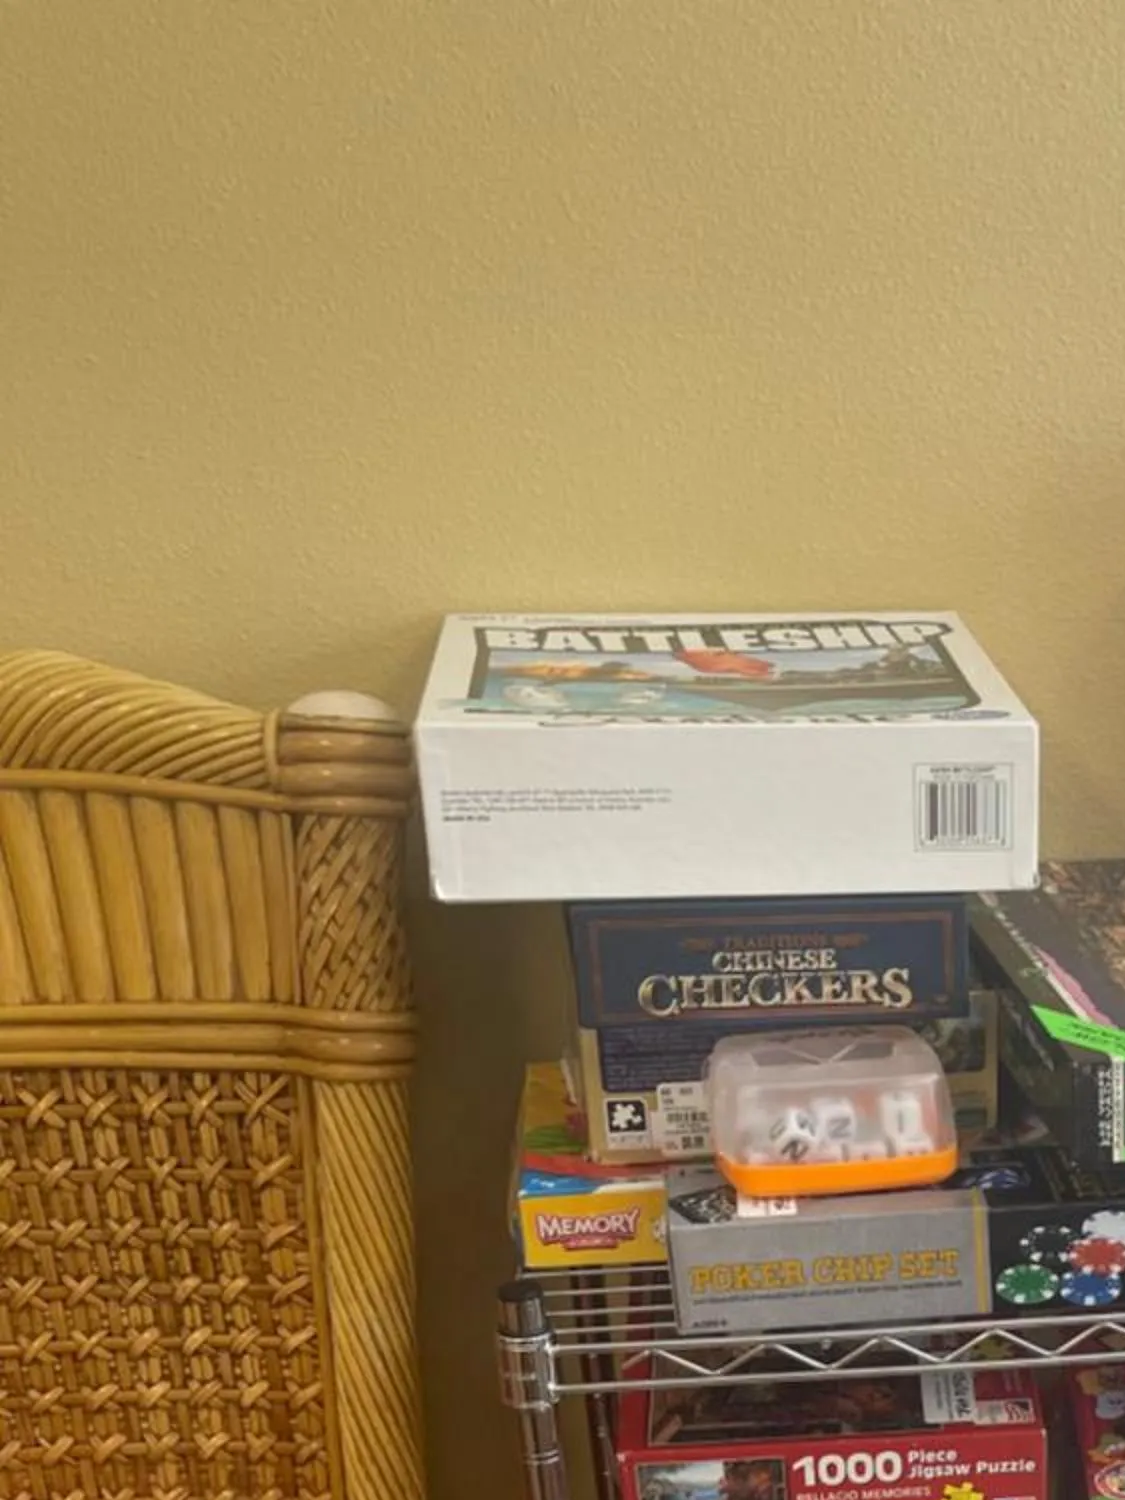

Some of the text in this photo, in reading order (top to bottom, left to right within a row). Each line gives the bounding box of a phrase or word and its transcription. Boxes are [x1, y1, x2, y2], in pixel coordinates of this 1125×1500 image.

[482, 620, 950, 653] BATTLESHIP
[711, 948, 838, 973] CHINESE
[637, 967, 914, 1018] CHECKERS
[536, 1207, 641, 1239] MEMORY
[690, 1258, 806, 1294] POKER
[812, 1251, 893, 1284] CHIP
[898, 1247, 961, 1279] SET
[792, 1448, 958, 1487] 1000 Piece
[907, 1458, 1036, 1480] Jigsaw Puzzle
[861, 1485, 931, 1500] MEMORIES
